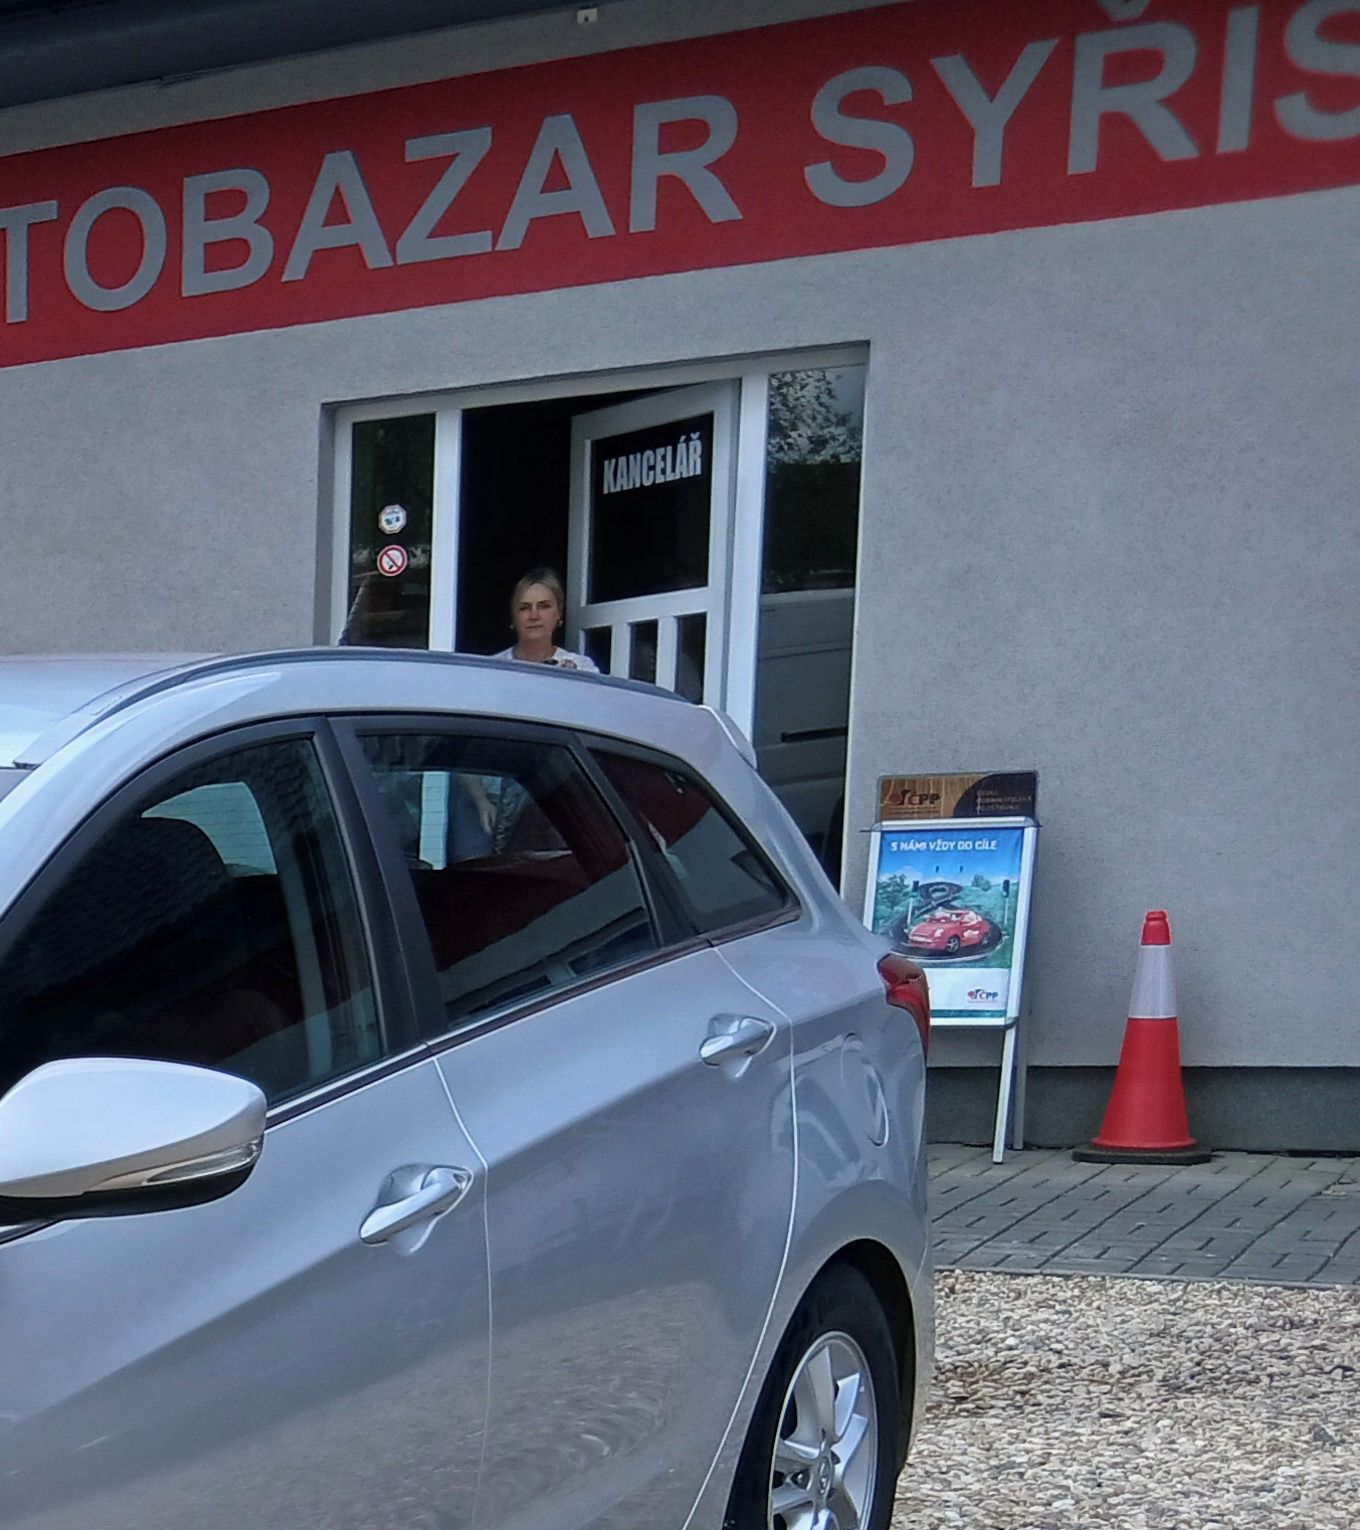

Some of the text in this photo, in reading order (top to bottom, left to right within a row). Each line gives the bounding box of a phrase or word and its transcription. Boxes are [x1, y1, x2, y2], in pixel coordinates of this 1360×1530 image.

[603, 432, 702, 495] KANCELÁŘ
[891, 841, 898, 851] S
[929, 838, 956, 851] VŽDY
[957, 840, 973, 850] DO
